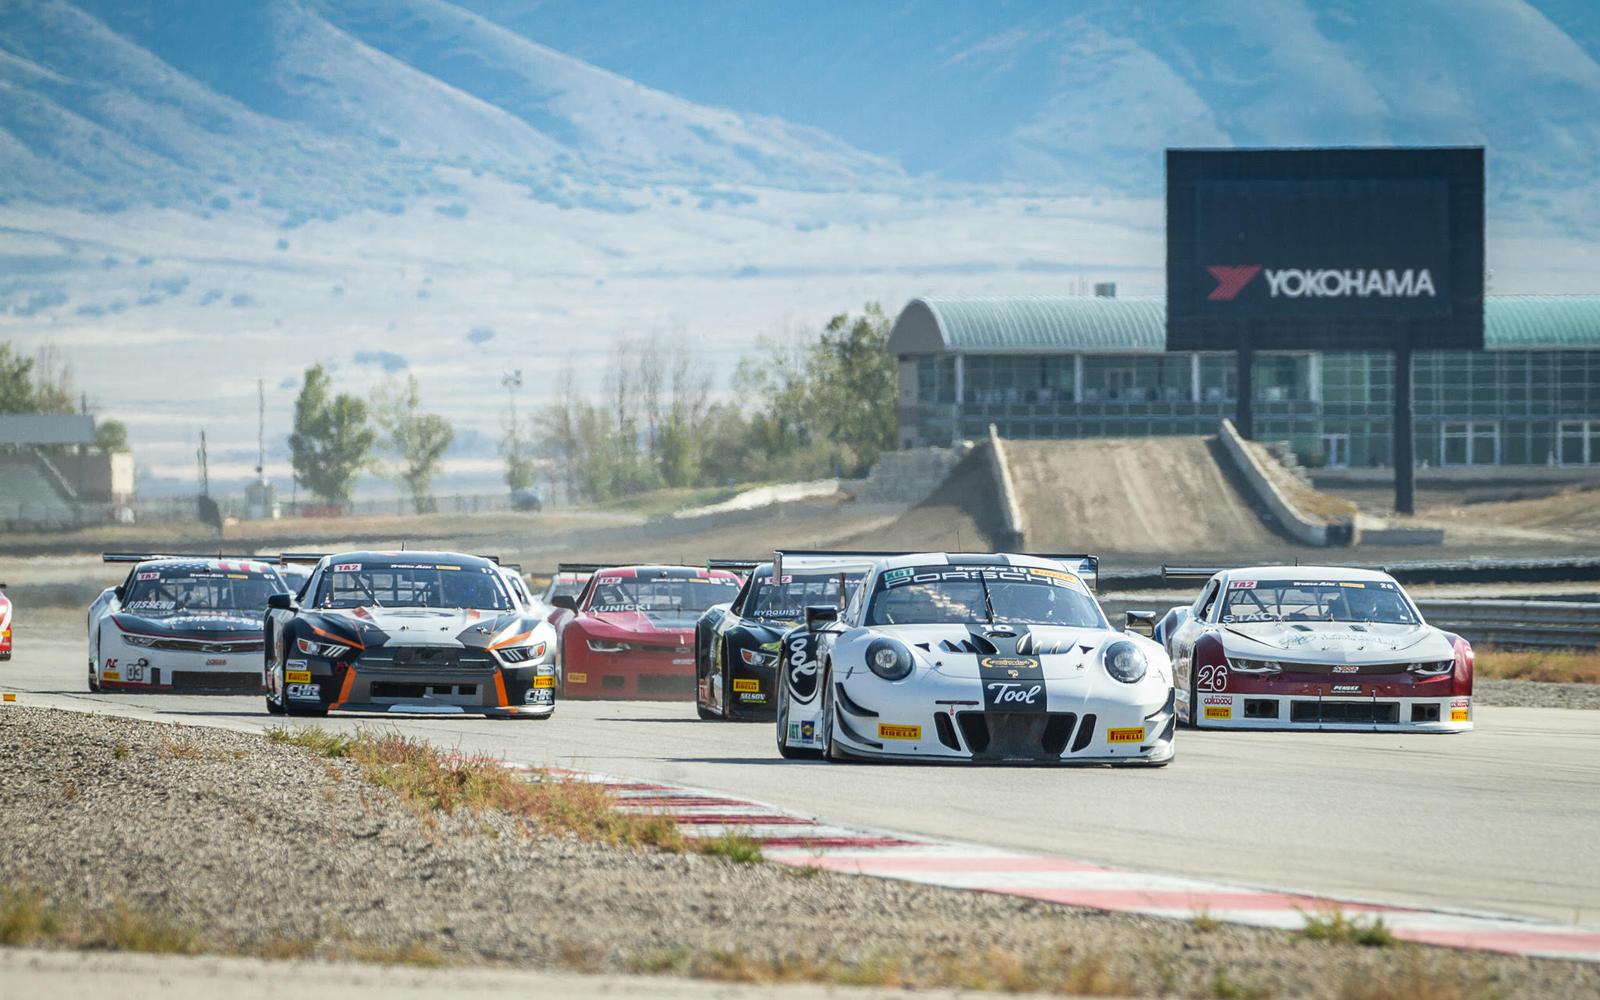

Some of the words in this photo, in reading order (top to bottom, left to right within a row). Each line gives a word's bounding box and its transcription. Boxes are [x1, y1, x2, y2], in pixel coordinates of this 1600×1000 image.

[1264, 268, 1437, 298] YOKOHAMA
[885, 569, 912, 580] XGT
[885, 571, 1078, 590] PORSCHE
[589, 603, 651, 611] KUNICKI
[1222, 612, 1290, 623] STACY
[127, 664, 144, 681] 03
[1197, 664, 1228, 692] 26
[987, 682, 1042, 704] Tool
[880, 726, 917, 737] PIRELLI
[1110, 729, 1143, 740] PIRELLI
